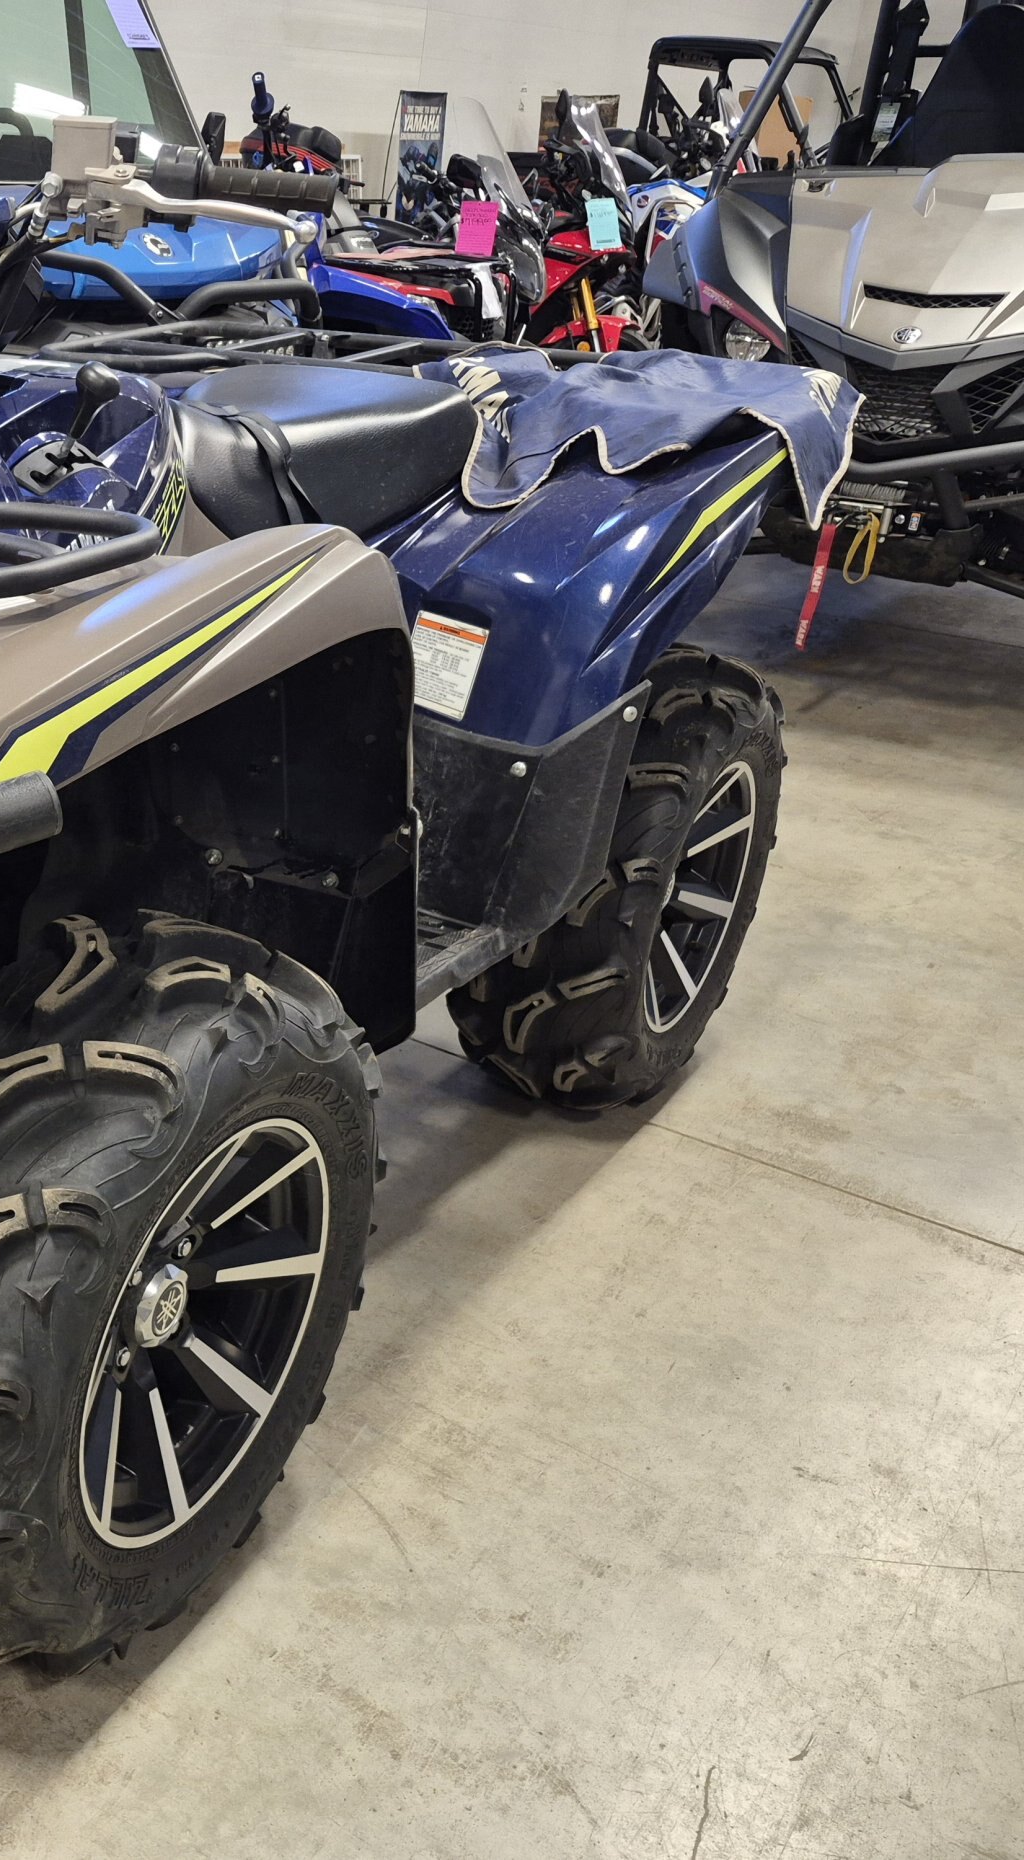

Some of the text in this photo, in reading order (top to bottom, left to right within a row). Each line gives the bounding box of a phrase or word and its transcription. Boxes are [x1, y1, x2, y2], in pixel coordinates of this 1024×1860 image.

[403, 114, 440, 132] YAMAHA
[809, 564, 826, 594] WARN
[794, 619, 810, 647] WARN
[282, 1071, 368, 1181] MAXXIS
